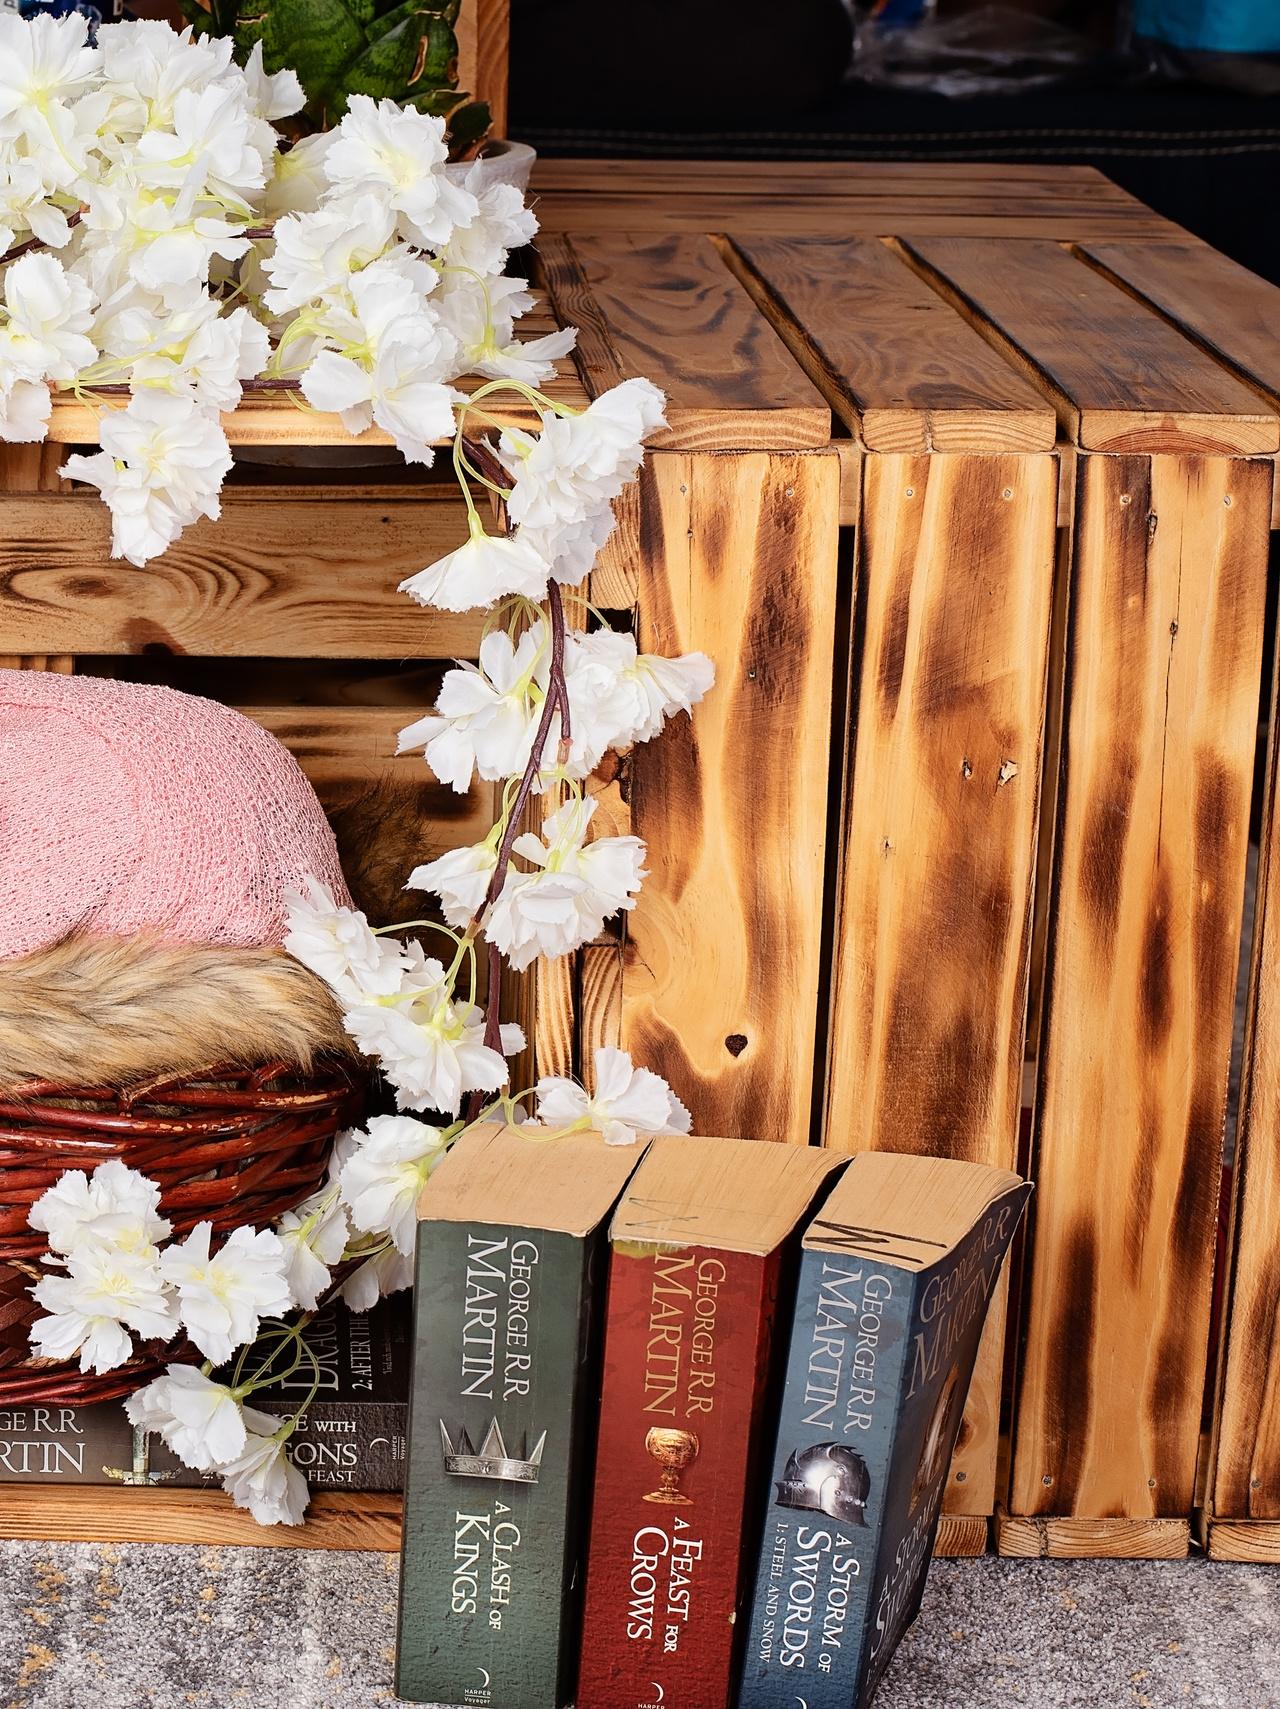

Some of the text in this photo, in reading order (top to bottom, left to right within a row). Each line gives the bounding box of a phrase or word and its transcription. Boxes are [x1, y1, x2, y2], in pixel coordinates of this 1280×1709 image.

[460, 1234, 509, 1400] MARTIN
[506, 1240, 540, 1348] GEORGE
[642, 1251, 696, 1417] MARTIN
[690, 1258, 728, 1366] GEORGE
[852, 1274, 894, 1382] GEORGE
[905, 1253, 1001, 1401] MARTIN
[920, 1244, 980, 1324] GEORGE
[350, 1340, 372, 1377] AFTER
[800, 1262, 864, 1431] MARTIN
[32, 1408, 85, 1434] R.R.
[314, 1420, 357, 1434] WITH
[308, 1470, 356, 1484] FEAST
[451, 1510, 492, 1615] KINGS
[488, 1500, 522, 1631] A CLASH OF
[626, 1526, 670, 1640] CROWS
[663, 1516, 704, 1654] A FEAST FOR
[758, 1535, 788, 1664] STEEL AND SNOW
[780, 1526, 834, 1668] SWORDS
[818, 1532, 862, 1674] A STORM OF
[464, 1688, 492, 1697] HARPER
[464, 1696, 491, 1705] Voyager
